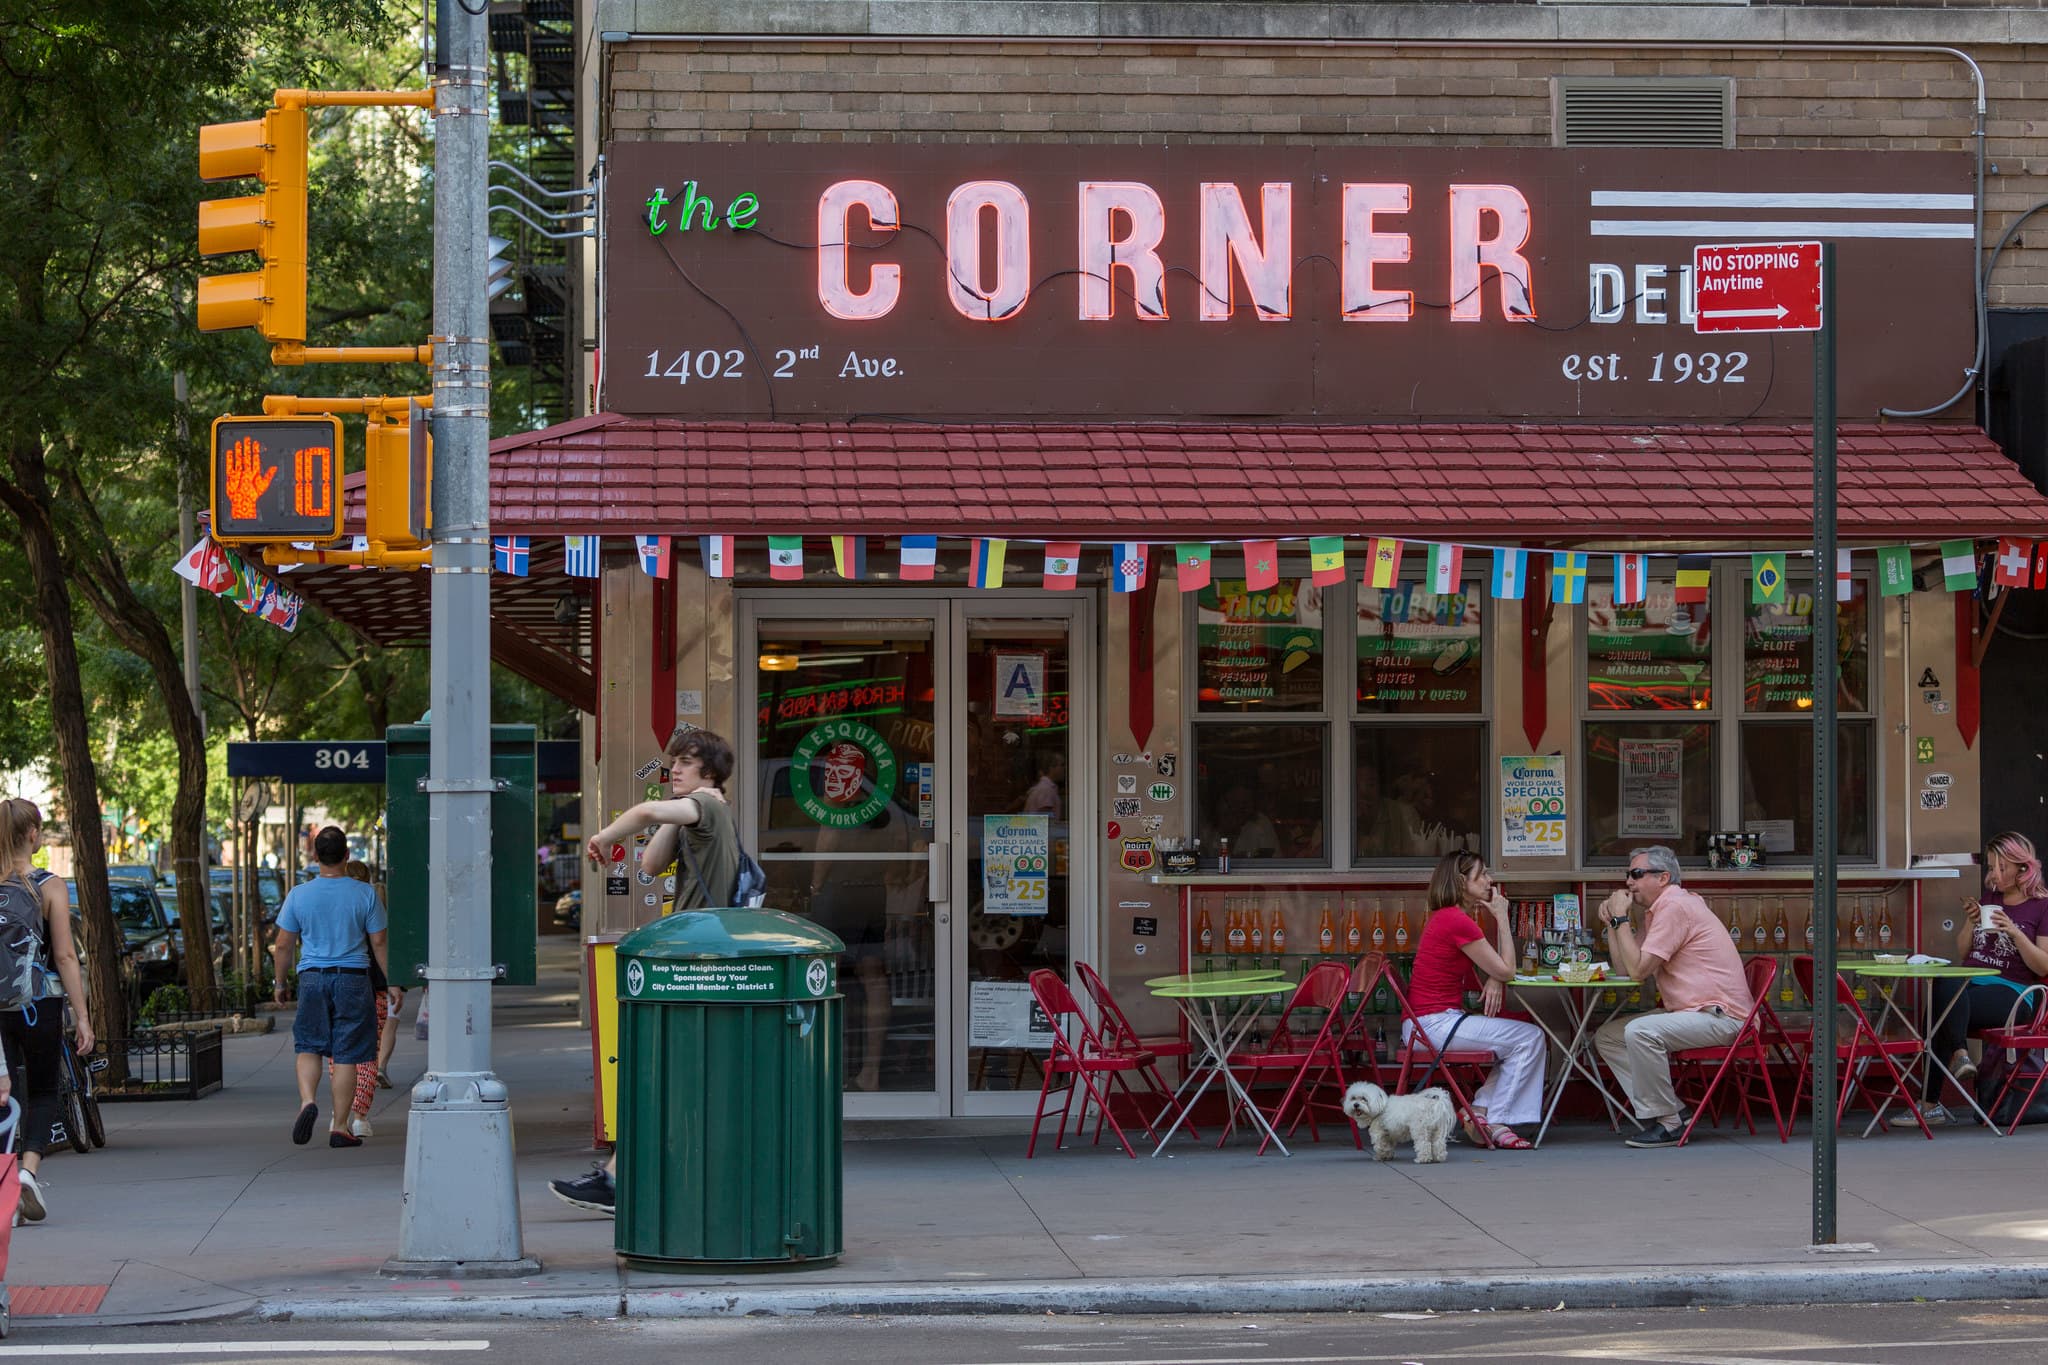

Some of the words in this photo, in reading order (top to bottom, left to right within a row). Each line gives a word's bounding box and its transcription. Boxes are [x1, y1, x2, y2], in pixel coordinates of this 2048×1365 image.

[645, 179, 760, 236] the
[817, 178, 1538, 323] CORNER
[1702, 255, 1723, 272] NO
[1726, 252, 1800, 271] STOPPING
[1702, 274, 1764, 293] Anytime
[643, 348, 744, 385] 1402
[773, 345, 820, 379] 2nd
[839, 351, 904, 379] Ave.
[1562, 352, 1629, 383] est.
[1647, 351, 1750, 384] 1932
[294, 446, 331, 517] 10
[1225, 594, 1296, 617] TACOS
[1380, 593, 1465, 615] TORTAS
[1219, 640, 1251, 651] POLLO
[1763, 641, 1796, 651] ELOTE
[1375, 656, 1411, 666] POLLO
[1765, 658, 1800, 669] SALSA
[1219, 672, 1268, 682] PESCADO
[1607, 665, 1672, 676] MARGARITAS
[1004, 664, 1035, 698] A
[1376, 672, 1416, 684] BISTEC
[1765, 674, 1807, 685] MOROS
[1219, 687, 1275, 697] COCHINITA
[1376, 689, 1416, 701] JAMON
[1418, 689, 1426, 701] Y
[1430, 689, 1468, 701] QUESO
[794, 747, 812, 771] LA
[812, 723, 893, 770] ESQUINA
[315, 749, 370, 769] 304
[1630, 751, 1657, 774] WORLD
[1658, 751, 1674, 773] CUP
[1512, 767, 1554, 780] Corona
[1929, 776, 1950, 785] WANDER
[1152, 785, 1170, 799] NH
[1504, 787, 1565, 798] SPECIALS
[803, 797, 824, 821] NEW
[830, 812, 859, 825] YORK
[861, 798, 884, 819] CITY
[996, 825, 1038, 838] Corona
[1525, 821, 1564, 842] $25
[987, 845, 1047, 856] SPECIALS
[1125, 842, 1151, 850] ROUTE
[1128, 855, 1147, 866] 66
[1008, 879, 1046, 900] $25
[652, 964, 669, 973] Keep
[671, 964, 688, 972] Your
[689, 964, 746, 973] Neighborhood
[748, 964, 774, 972] Clean.
[673, 974, 715, 982] Sponsored
[716, 974, 727, 982] by
[652, 983, 665, 991] City
[666, 983, 695, 991] Council
[736, 982, 767, 991] District
